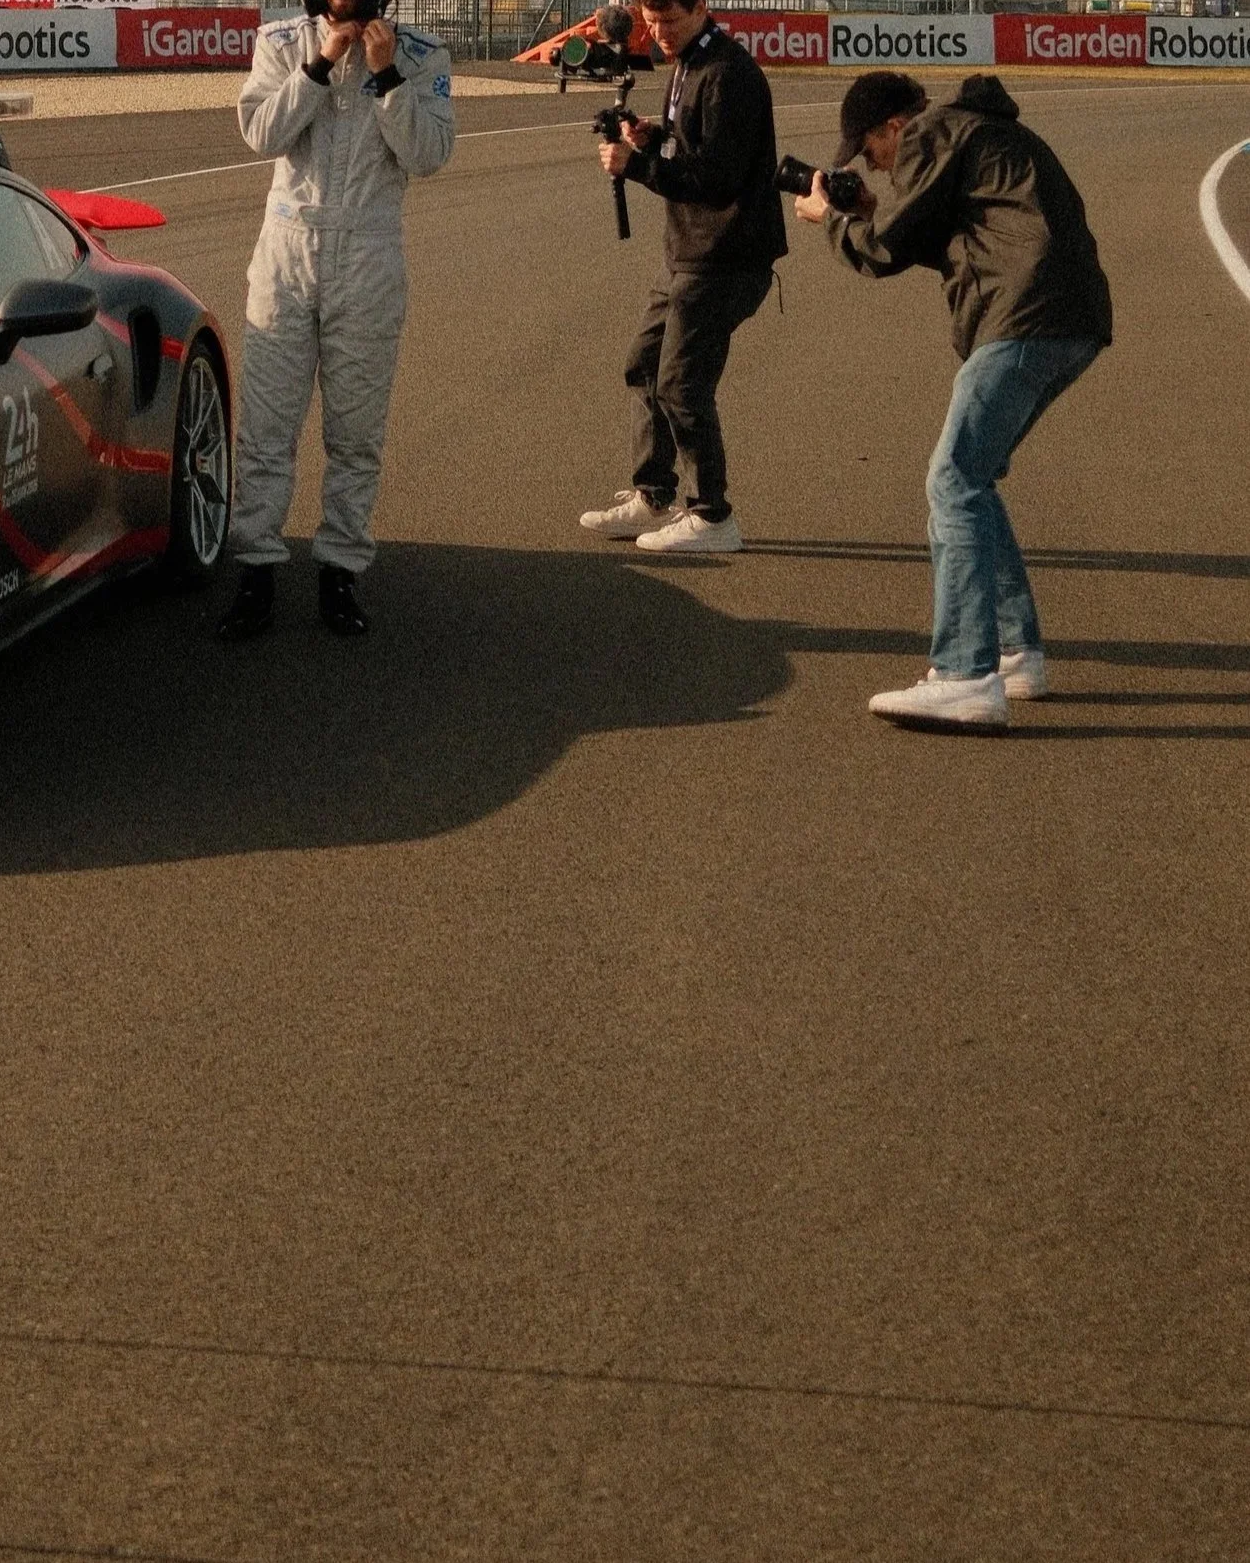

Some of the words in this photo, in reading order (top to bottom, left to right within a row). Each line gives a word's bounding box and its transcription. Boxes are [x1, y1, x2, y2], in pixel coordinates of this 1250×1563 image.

[142, 19, 257, 57] iGarden
[832, 24, 968, 58] Robotics
[1025, 23, 1141, 58] iGarden
